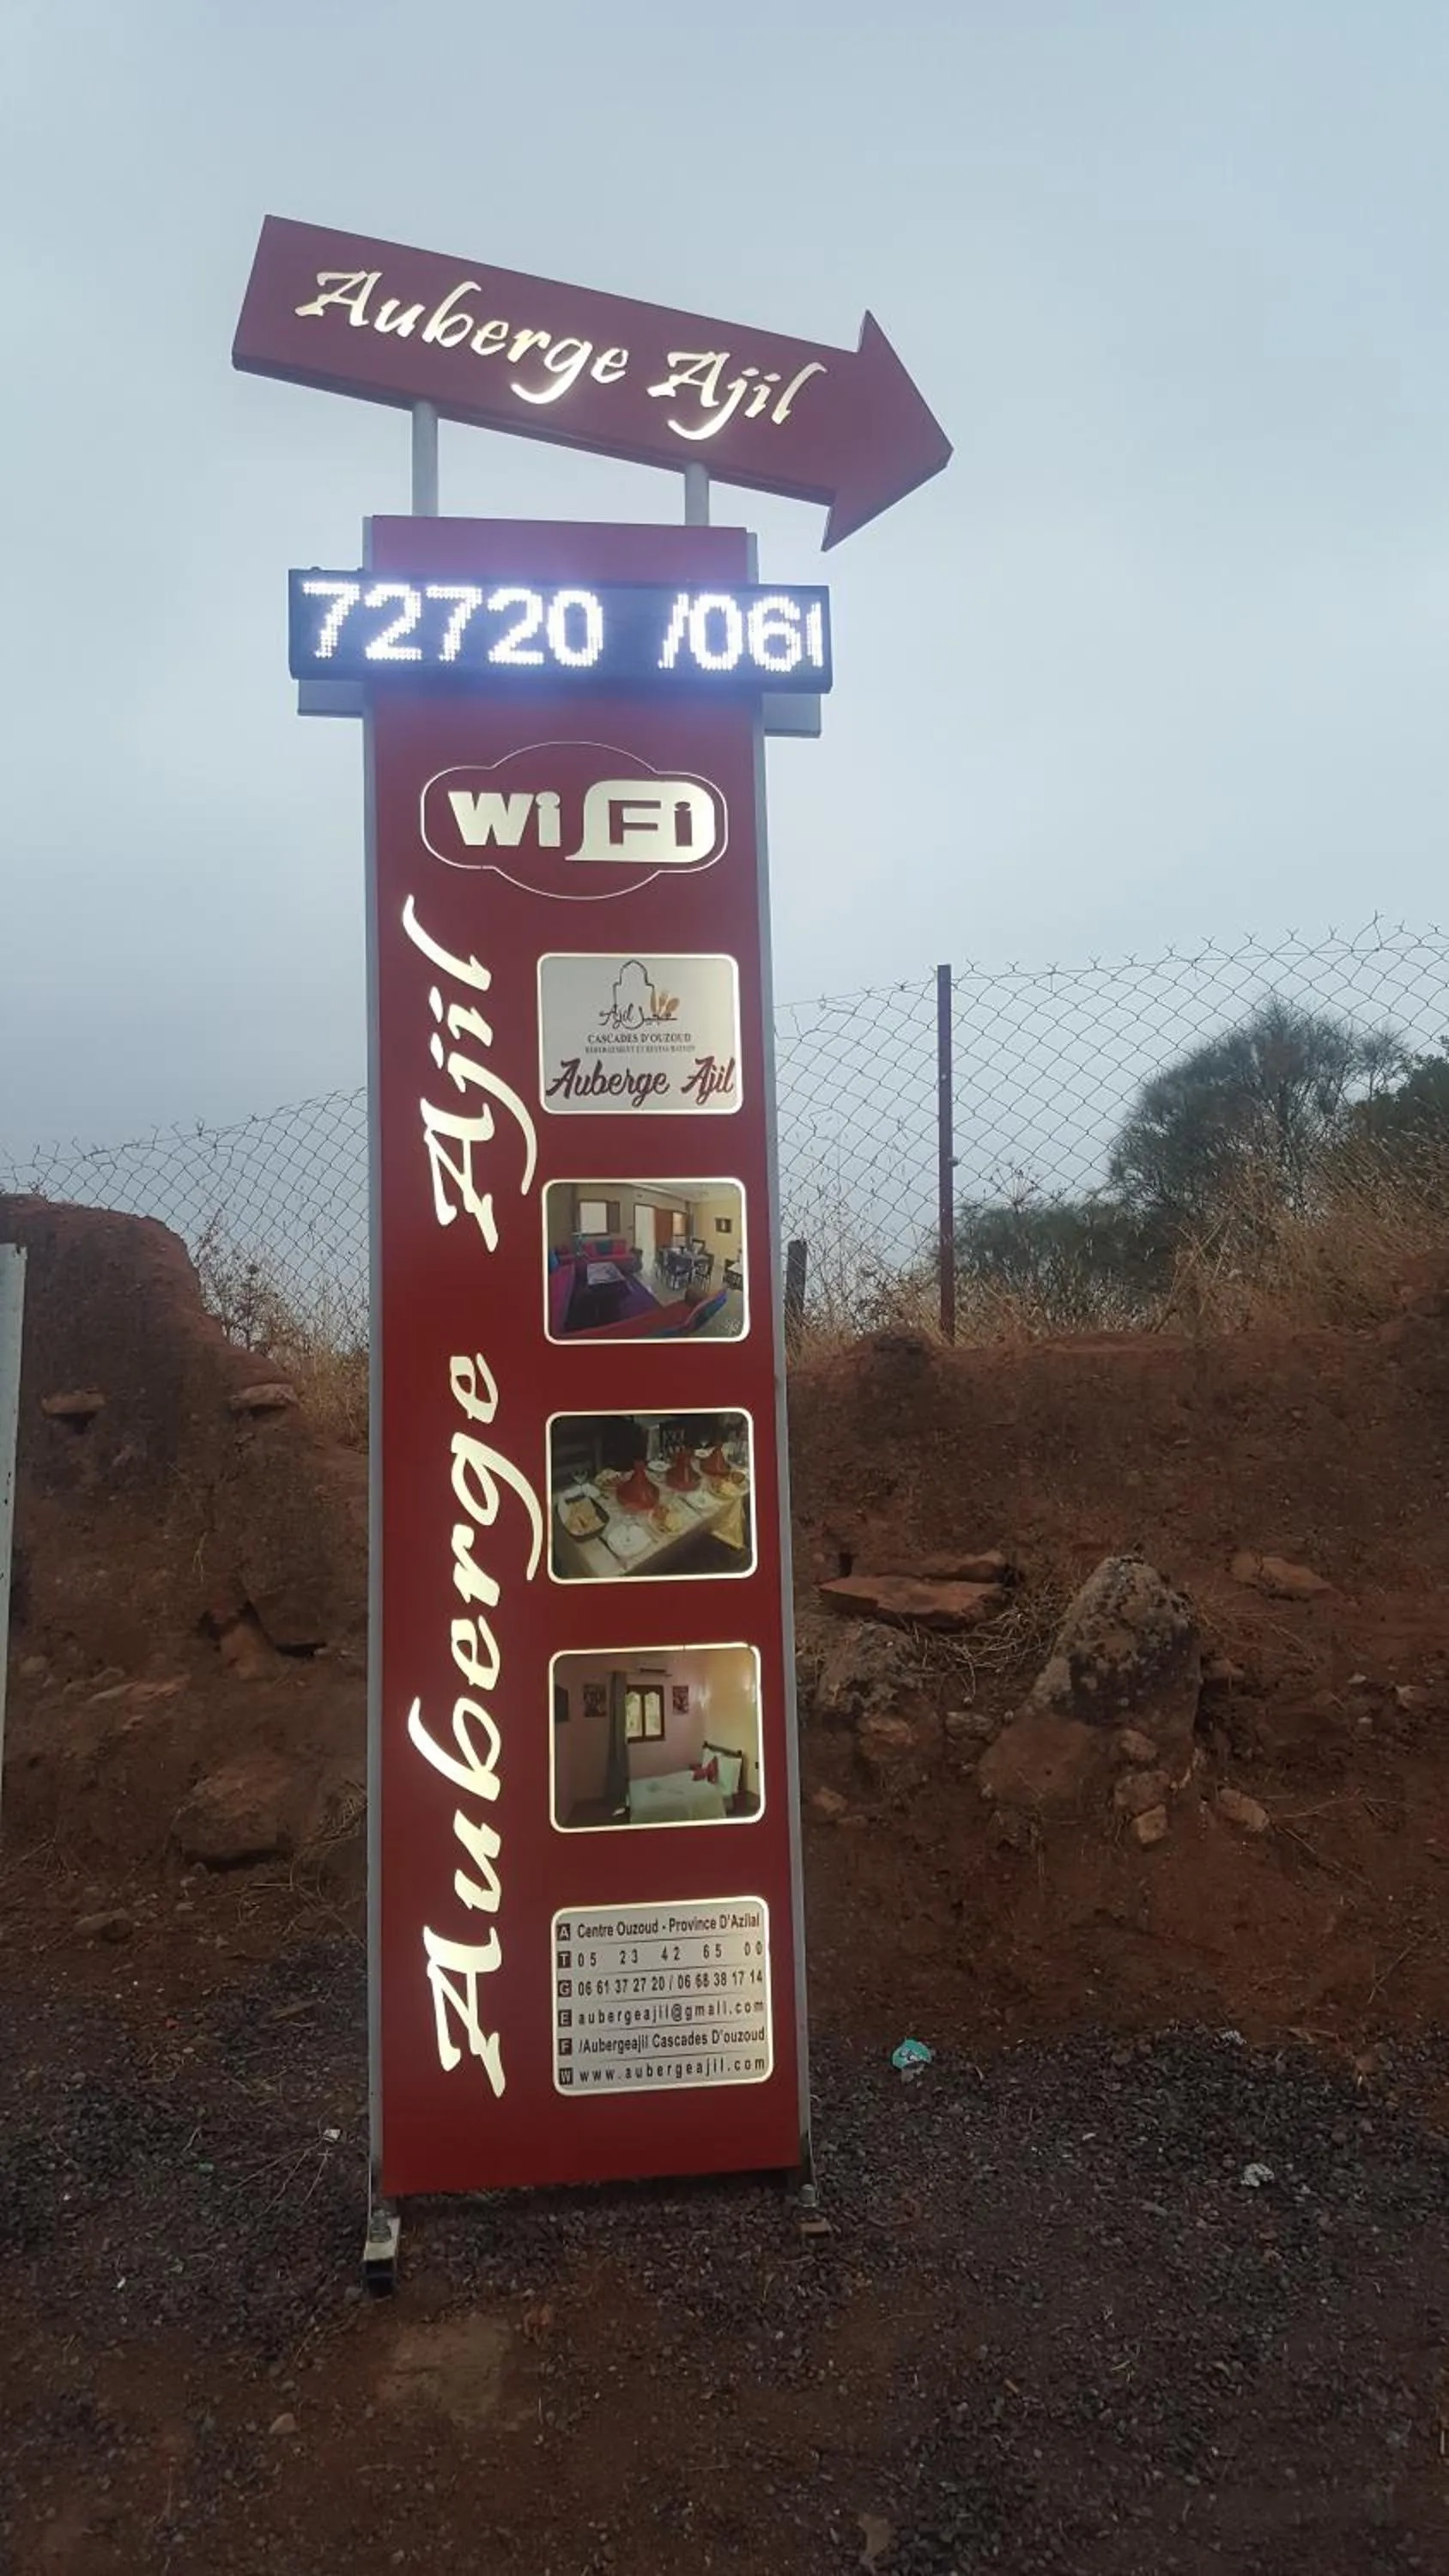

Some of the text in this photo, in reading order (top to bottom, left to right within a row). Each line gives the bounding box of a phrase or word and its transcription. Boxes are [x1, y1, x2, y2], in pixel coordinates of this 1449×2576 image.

[294, 270, 827, 440] Auberge Ajil
[302, 581, 604, 669] 72720
[546, 1055, 736, 1108] Auberge Ajil
[402, 894, 543, 2098] Auberge Ajil
[558, 1924, 570, 1940] A
[578, 1923, 614, 1939] Centre
[616, 1918, 658, 1936] Ouzoud
[669, 1917, 716, 1932] Province
[558, 1953, 571, 1967] T
[578, 1981, 591, 1996] 06
[597, 1979, 609, 1995] 61
[615, 1978, 627, 1994] 37
[633, 1978, 646, 1992] 27
[652, 1976, 665, 1991] 20
[677, 1974, 691, 1990] 06
[713, 1971, 727, 1986] 38
[732, 1971, 744, 1985] 17
[749, 1969, 762, 1984] 14
[559, 2010, 571, 2026] E
[560, 2039, 572, 2055] F
[652, 2030, 707, 2048] Cascades
